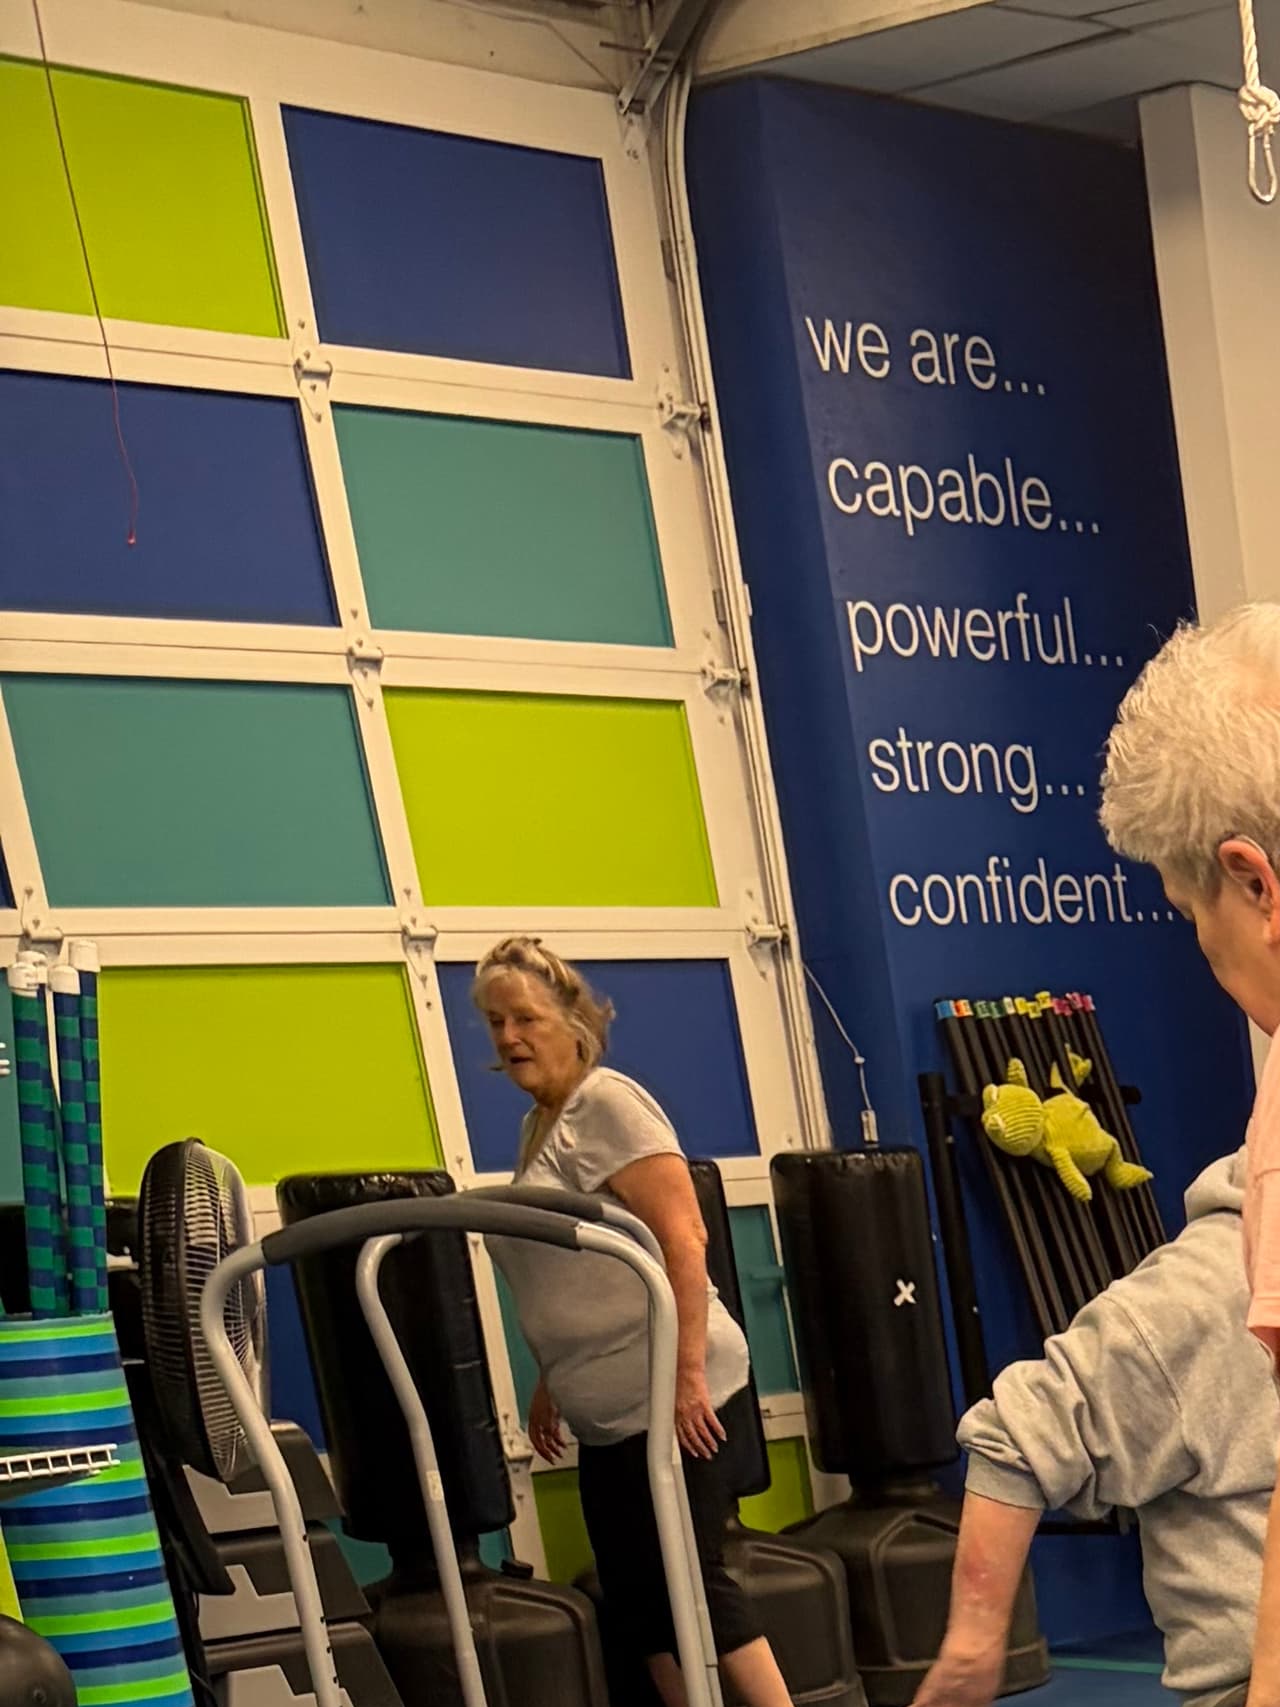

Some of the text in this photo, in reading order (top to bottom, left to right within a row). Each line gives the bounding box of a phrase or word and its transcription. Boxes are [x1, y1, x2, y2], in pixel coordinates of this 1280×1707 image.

[805, 315, 1046, 396] we are...
[827, 452, 1100, 537] capable...
[845, 591, 1124, 673] powerful...
[867, 726, 1086, 814] strong...
[888, 855, 1175, 926] confident...
